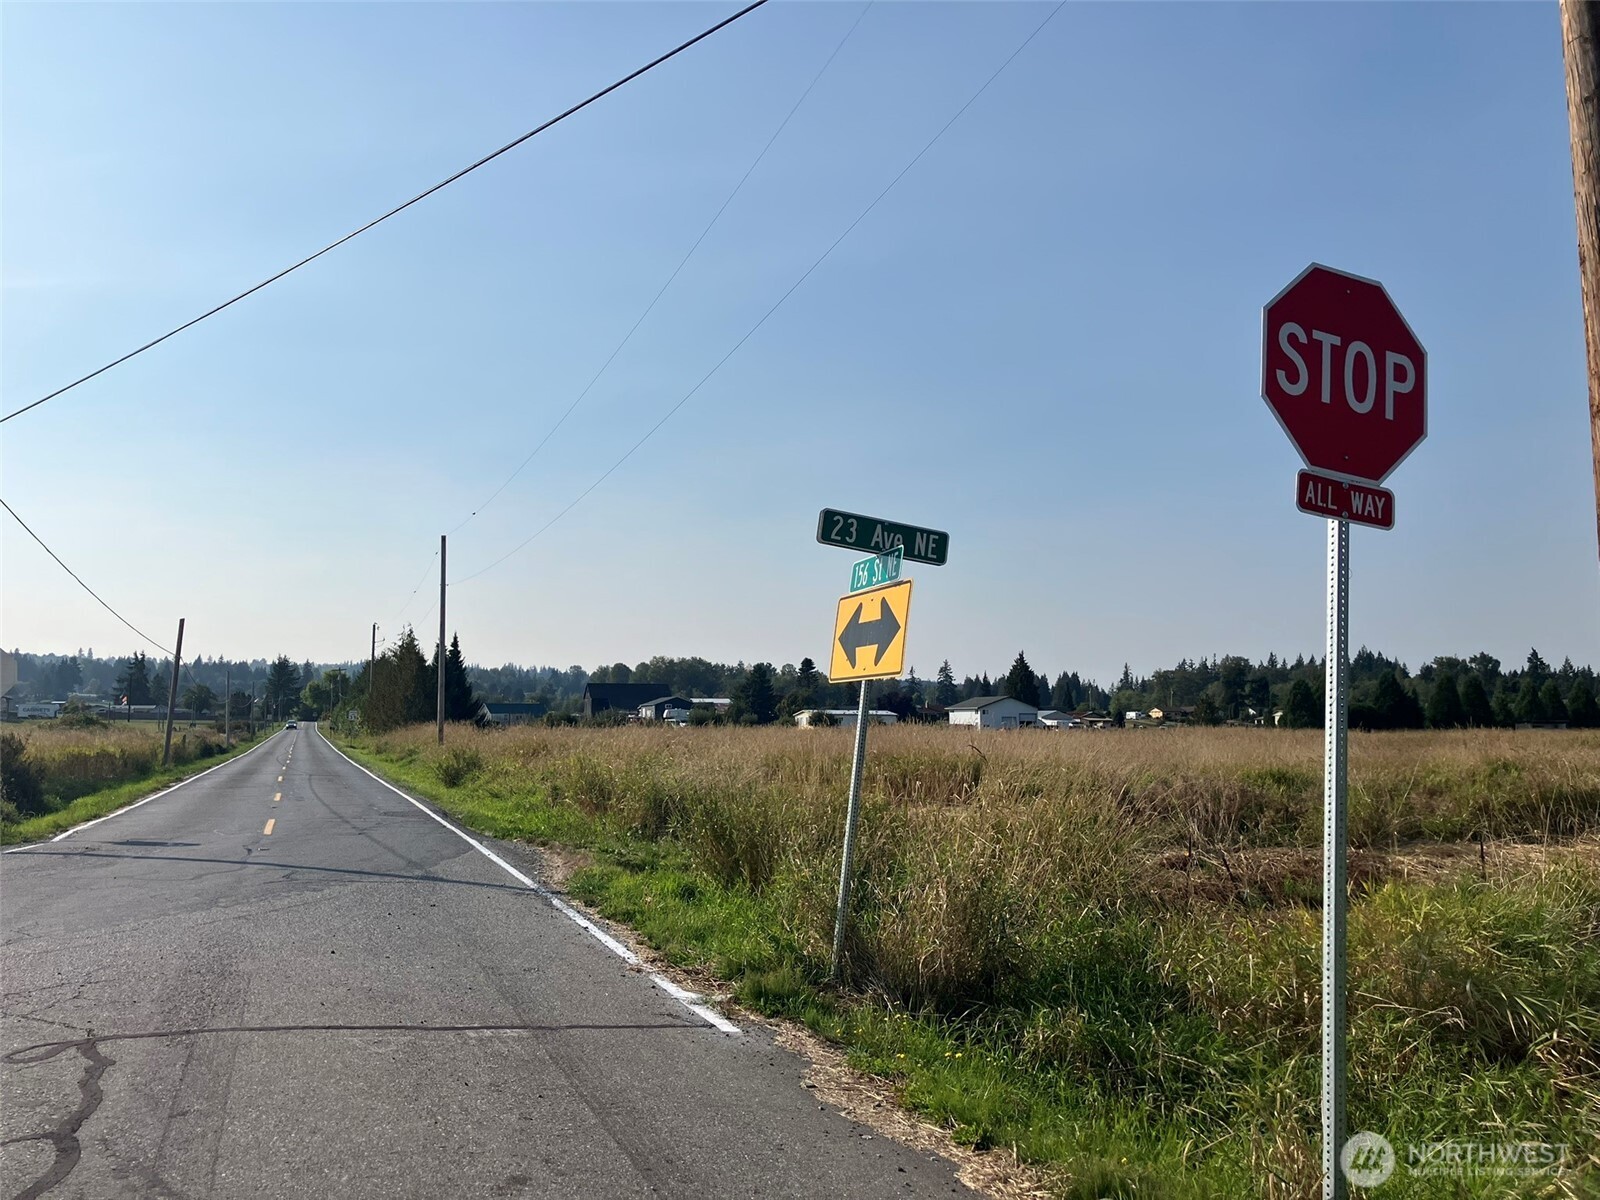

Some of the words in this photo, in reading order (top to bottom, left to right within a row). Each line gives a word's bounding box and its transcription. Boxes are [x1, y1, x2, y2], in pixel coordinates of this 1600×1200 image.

[1276, 322, 1415, 420] STOP
[1305, 480, 1337, 510] ALL
[1351, 490, 1386, 519] WAY
[831, 515, 858, 543] 23
[870, 523, 903, 550] Ave
[914, 532, 939, 559] NE
[854, 562, 870, 589] 156
[872, 558, 883, 584] St
[886, 551, 899, 579] NE
